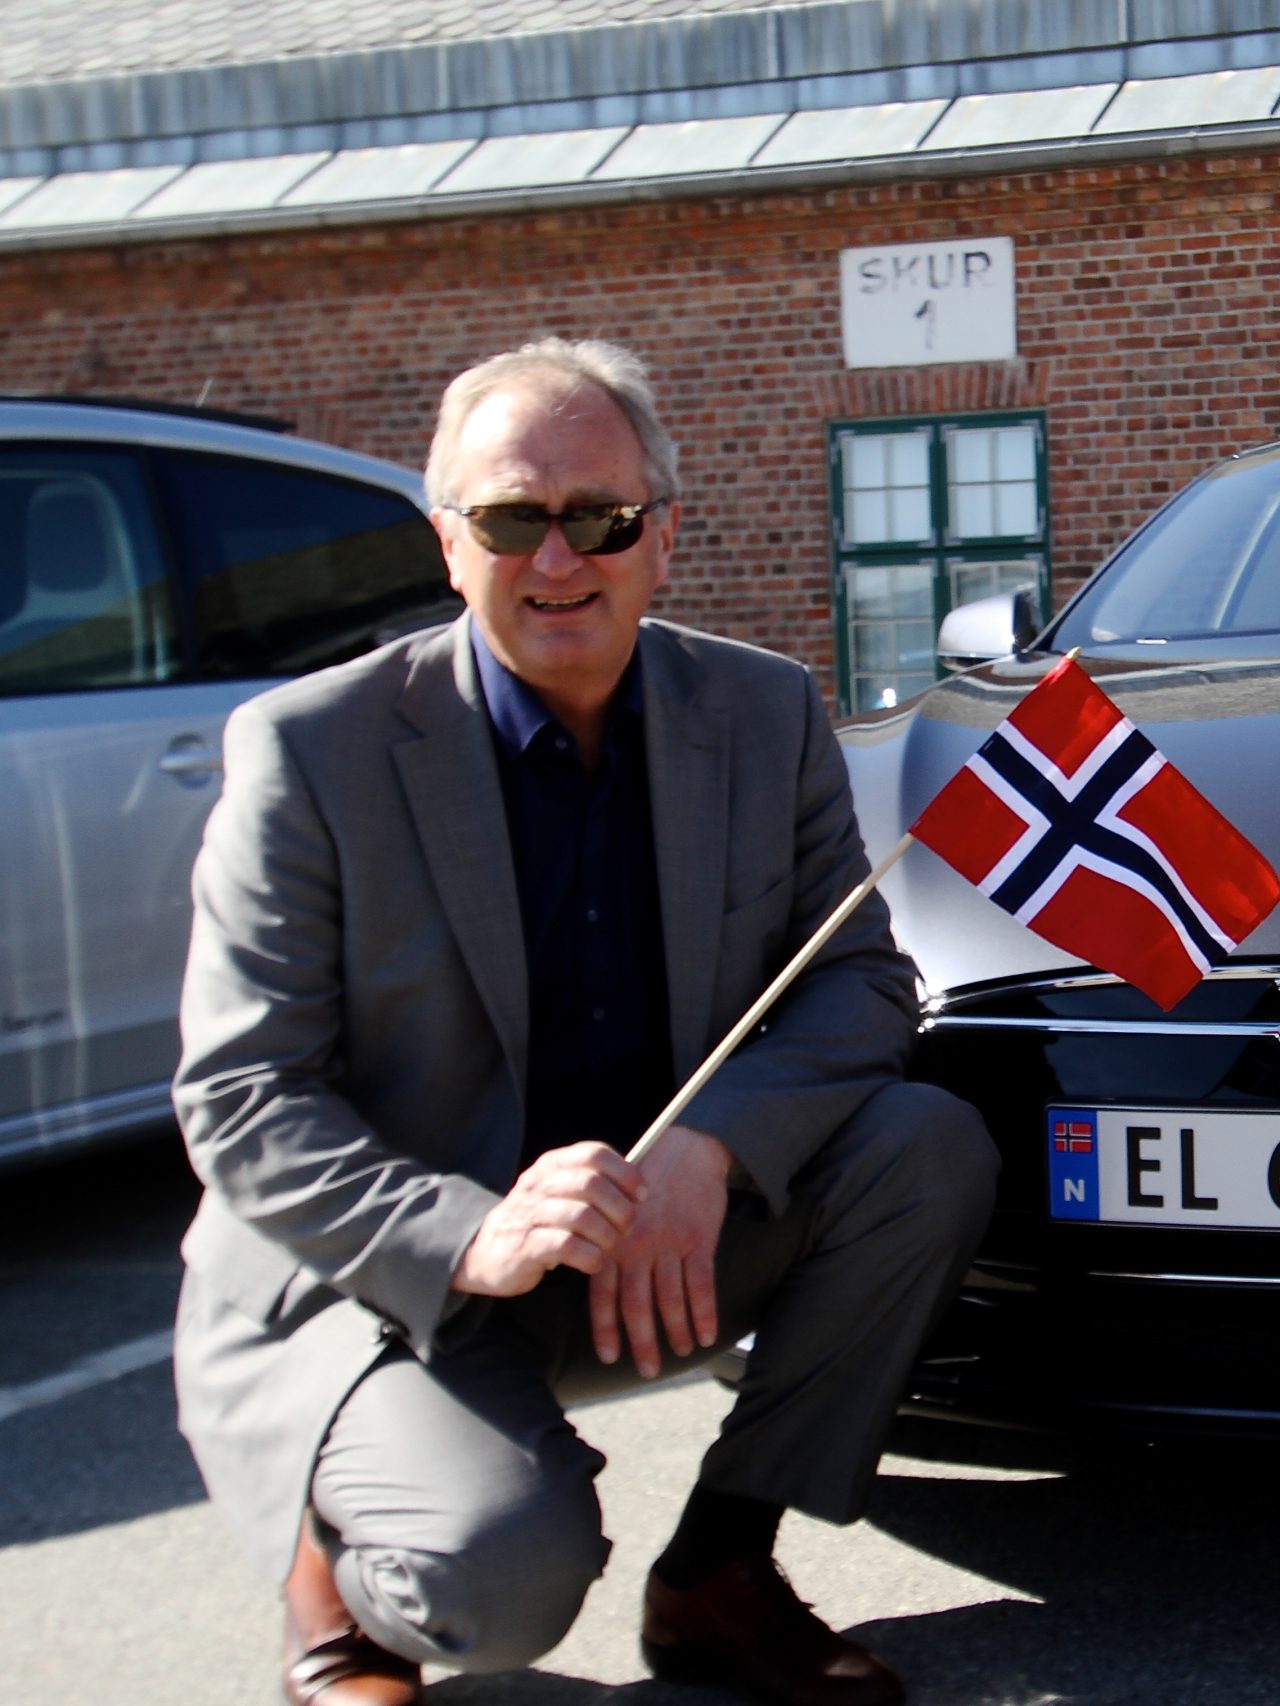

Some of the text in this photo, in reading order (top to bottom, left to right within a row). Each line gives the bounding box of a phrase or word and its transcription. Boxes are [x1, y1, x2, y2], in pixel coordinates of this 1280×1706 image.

[858, 250, 995, 295] SKUR
[914, 298, 937, 350] 1
[1063, 1178, 1086, 1203] N
[1125, 1125, 1219, 1211] EL
